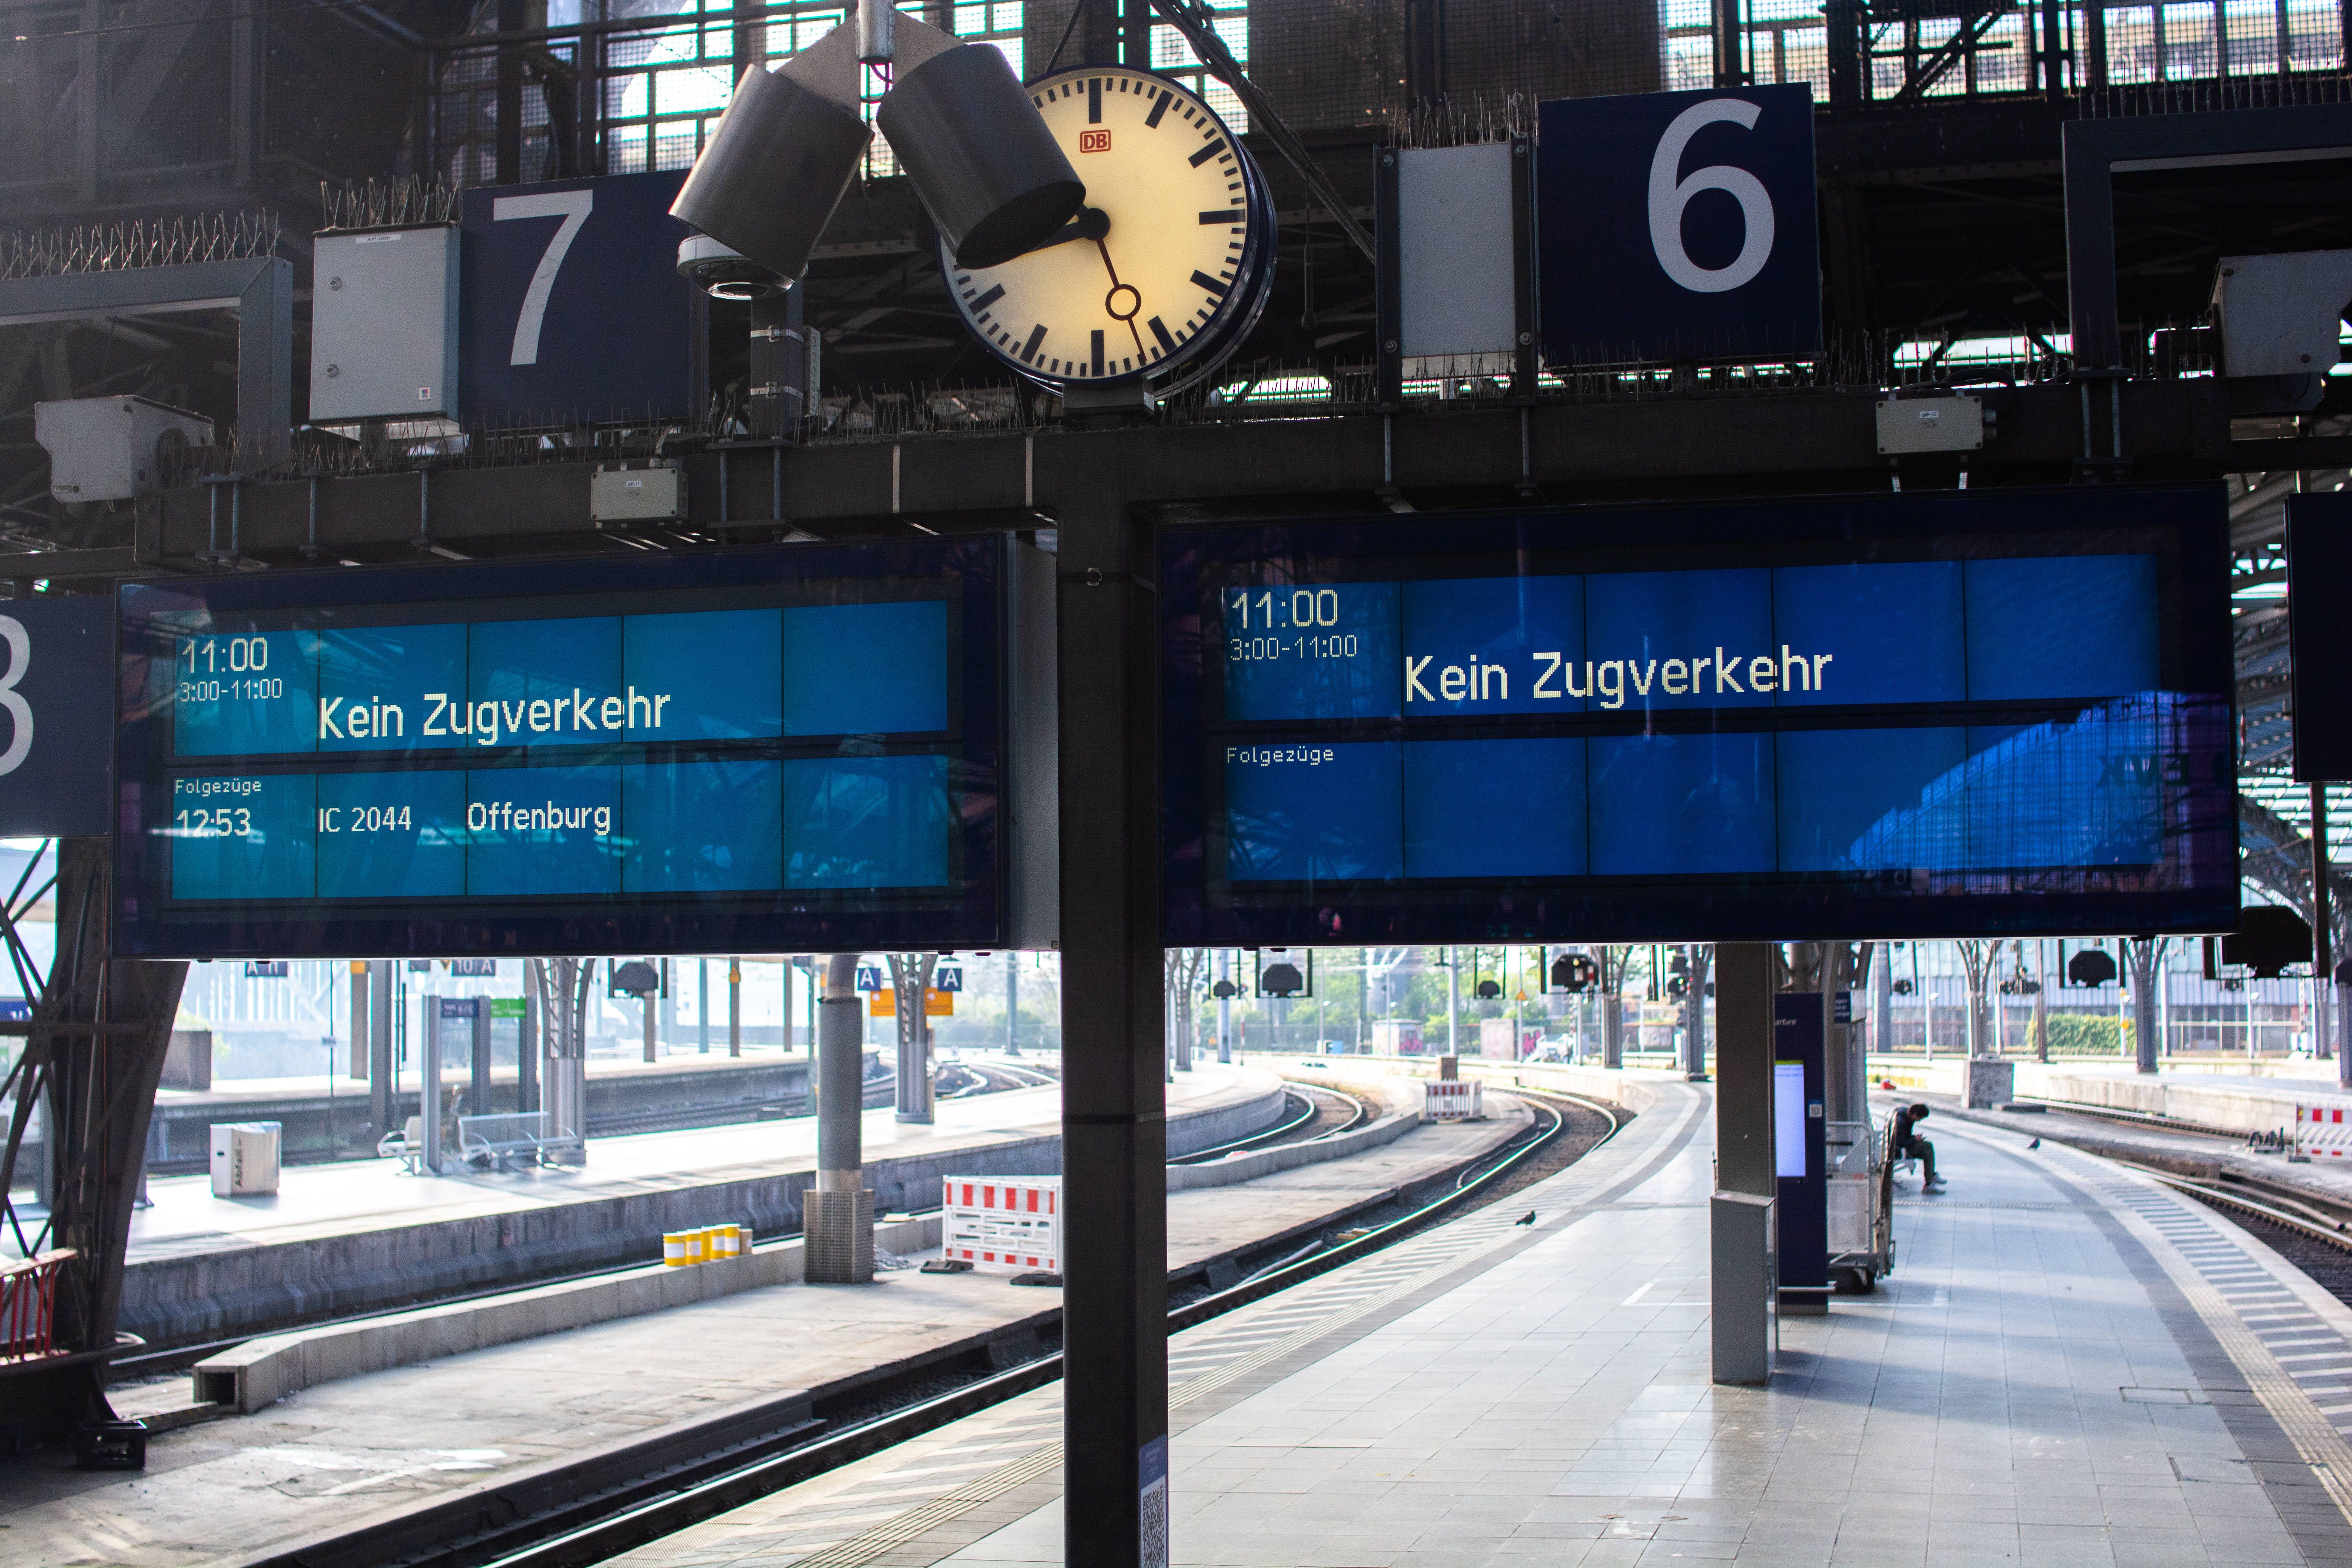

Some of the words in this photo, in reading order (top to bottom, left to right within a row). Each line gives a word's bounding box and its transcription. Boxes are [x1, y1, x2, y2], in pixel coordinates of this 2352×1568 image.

[1084, 133, 1107, 149] DB
[1649, 98, 1775, 292] 6
[493, 189, 593, 365] 7
[1232, 589, 1338, 628] 11:00
[181, 637, 268, 673] 11:00
[1230, 635, 1357, 661] 3:00-11:00
[180, 678, 282, 702] 3:00-11:00
[1406, 654, 1508, 702] Kein
[1533, 644, 1833, 709] Zugverkehr
[320, 695, 403, 739] Kein
[423, 686, 671, 746] Zugverkehr
[1227, 746, 1334, 766] Folgezüge
[175, 779, 262, 797] Folgezüge
[176, 808, 250, 837] 12:53
[319, 808, 340, 833] IC
[351, 806, 411, 832] 2044
[468, 800, 610, 836] Offenburg
[859, 968, 874, 987] A
[943, 969, 959, 987] A
